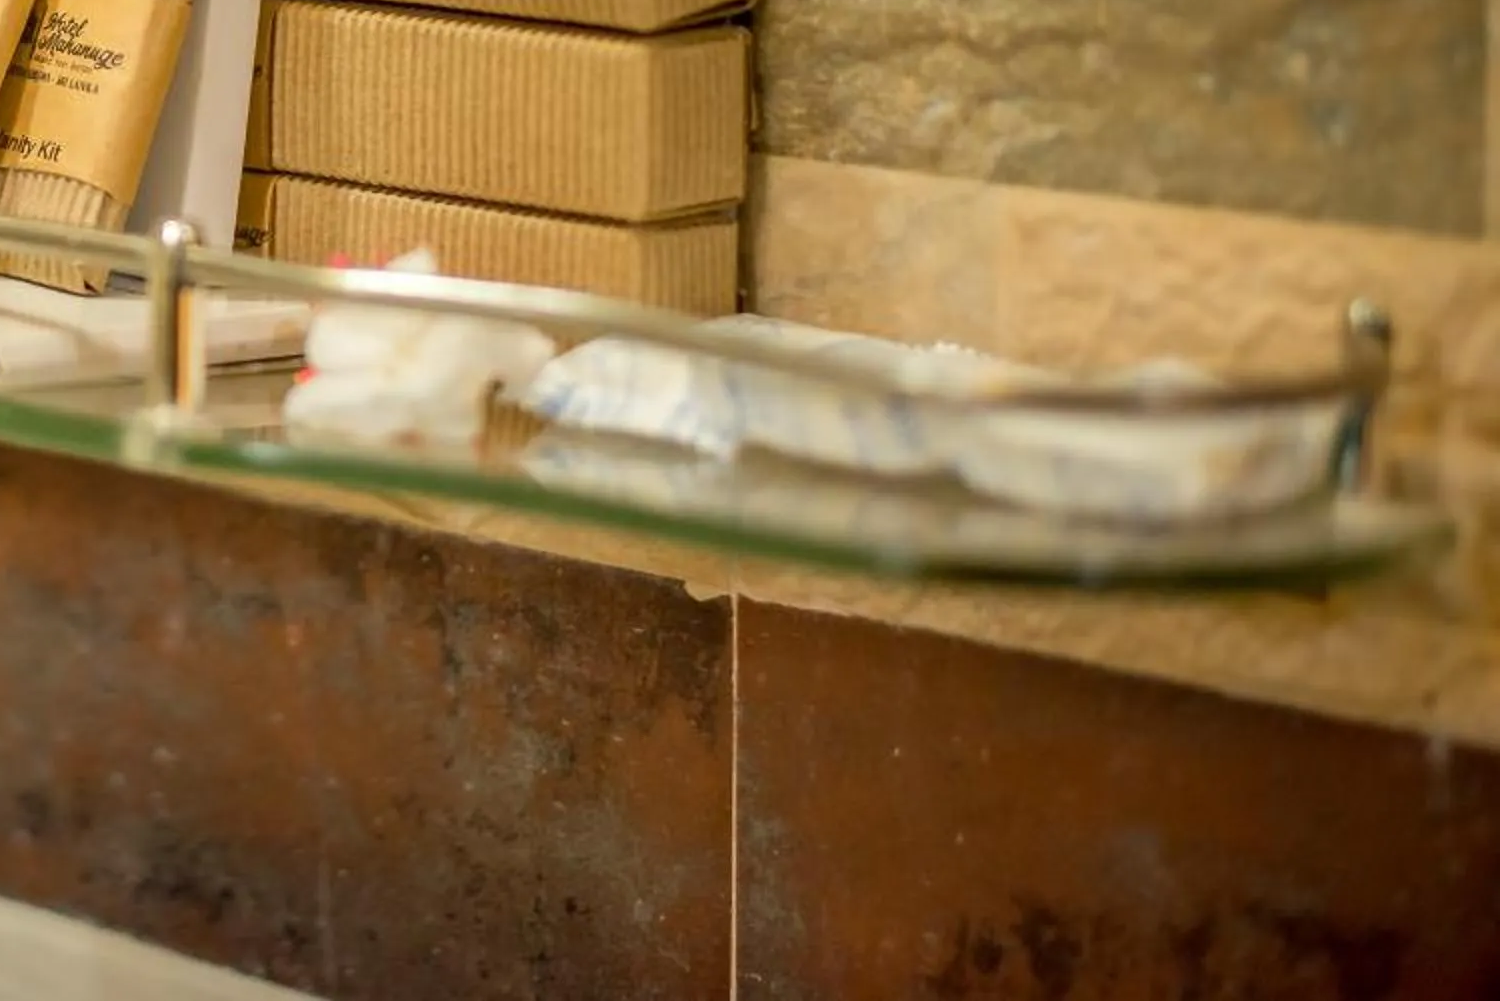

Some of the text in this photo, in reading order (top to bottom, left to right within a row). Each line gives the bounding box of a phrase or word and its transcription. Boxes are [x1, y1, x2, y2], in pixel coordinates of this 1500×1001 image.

[43, 11, 89, 37] Hotel
[37, 32, 125, 69] Mahanuge
[37, 139, 63, 162] Kit
